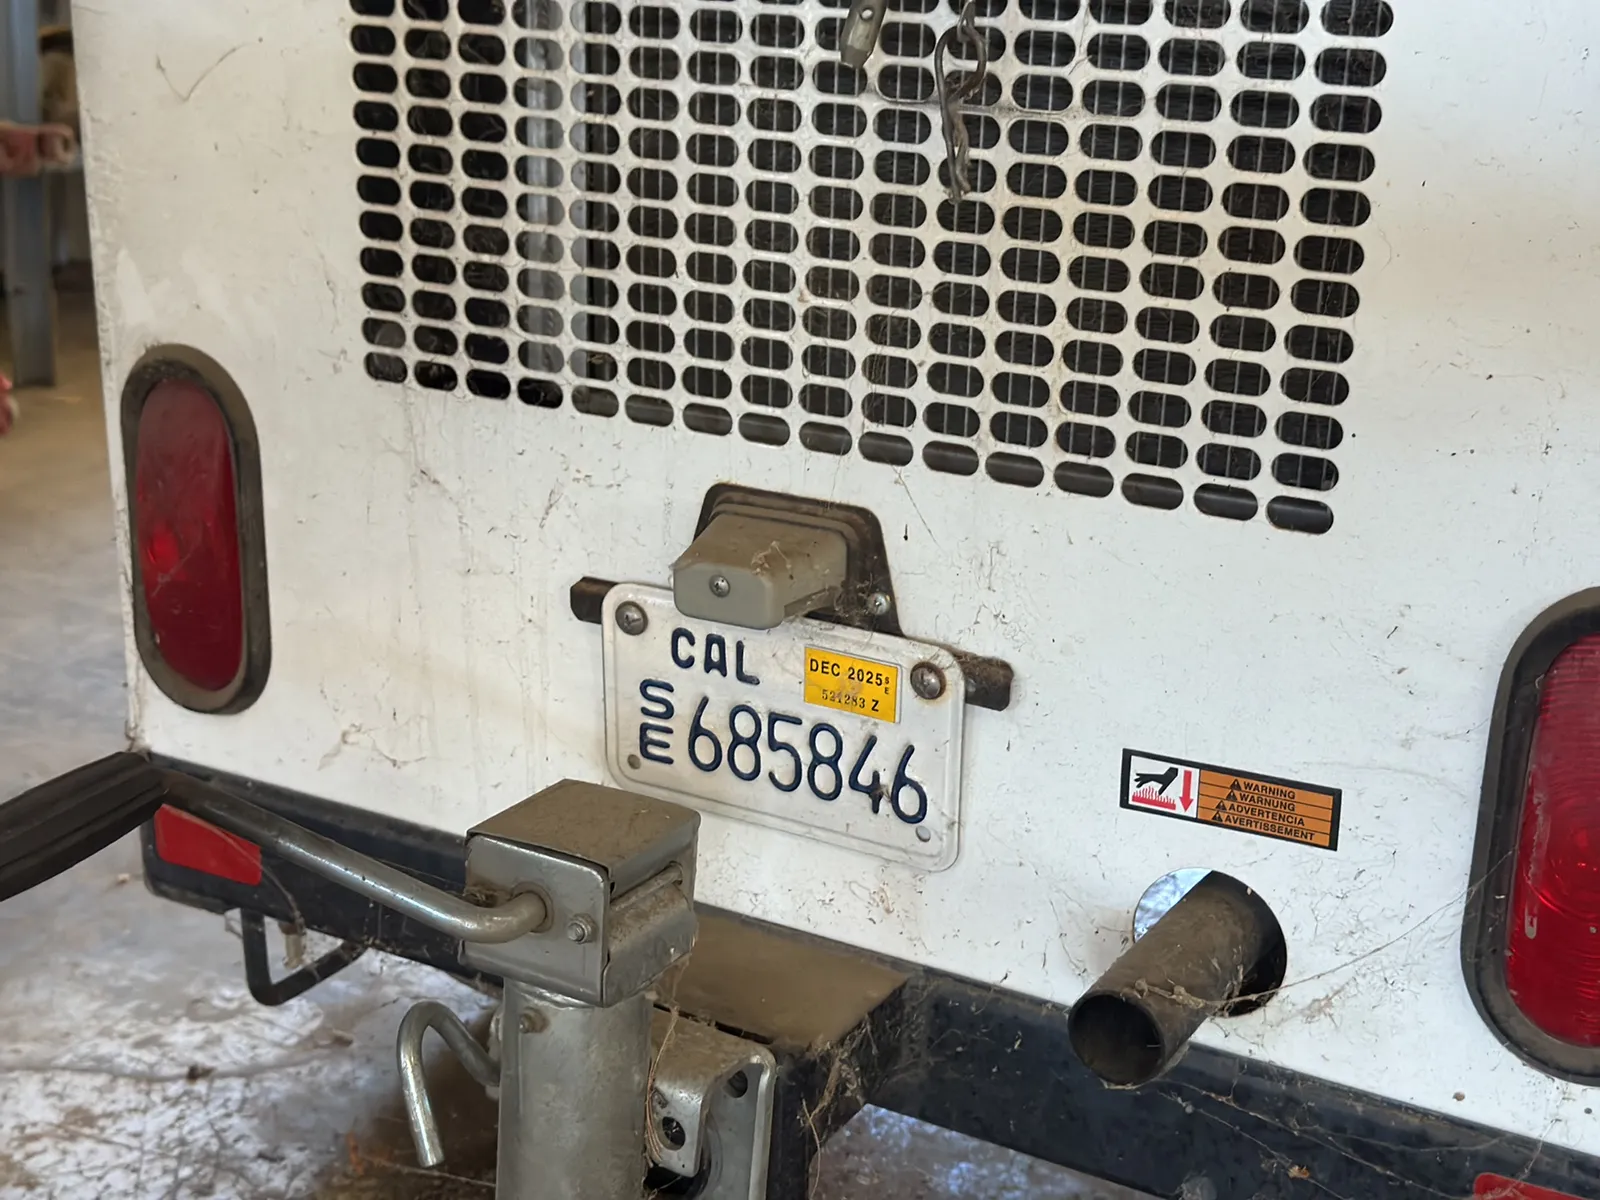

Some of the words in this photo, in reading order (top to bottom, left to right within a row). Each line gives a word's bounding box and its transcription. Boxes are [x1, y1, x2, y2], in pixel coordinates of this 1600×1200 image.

[671, 627, 760, 686] CAL
[810, 658, 841, 677] DEC
[848, 667, 883, 687] 2025
[871, 699, 880, 712] Z
[688, 696, 928, 824] 685846
[1239, 793, 1296, 812] WARNUNG
[1243, 781, 1296, 800] WARNING
[1228, 804, 1305, 827] ADVERTENCIA
[1224, 815, 1315, 841] AVERTISSEMENT
